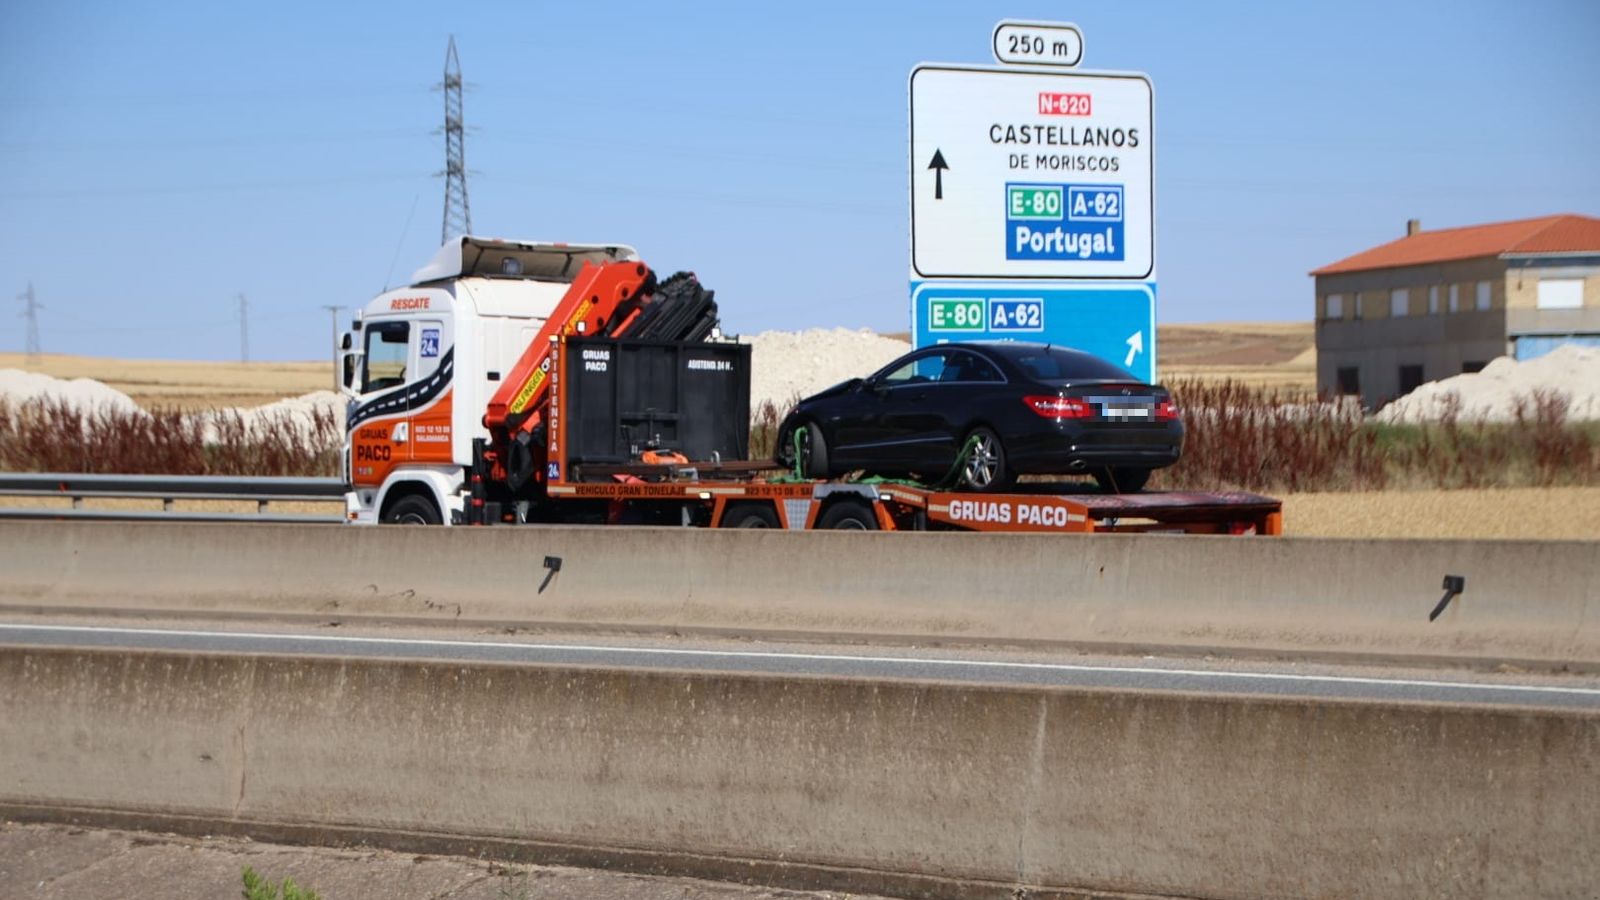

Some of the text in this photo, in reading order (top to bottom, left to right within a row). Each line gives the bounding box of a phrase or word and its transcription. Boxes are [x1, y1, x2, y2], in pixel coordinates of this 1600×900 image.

[1008, 34, 1068, 56] 250 m
[1040, 94, 1090, 115] N-620
[989, 123, 1139, 148] CASTELLANOS
[1009, 154, 1120, 172] DE MORISCOS
[1011, 191, 1118, 216] E-80 A-62
[1016, 226, 1115, 258] Portugal
[391, 297, 430, 310] RESCATE
[933, 303, 1040, 326] E-80 A-62
[582, 350, 610, 361] GRUAS
[585, 361, 608, 372] PACO
[511, 367, 545, 413] PALFINGER
[360, 428, 388, 440] GRUAS
[357, 444, 391, 461] PACO
[575, 485, 687, 497] VEHICULO GRAN TONELAJE
[949, 500, 1067, 527] GRUAS PACO
